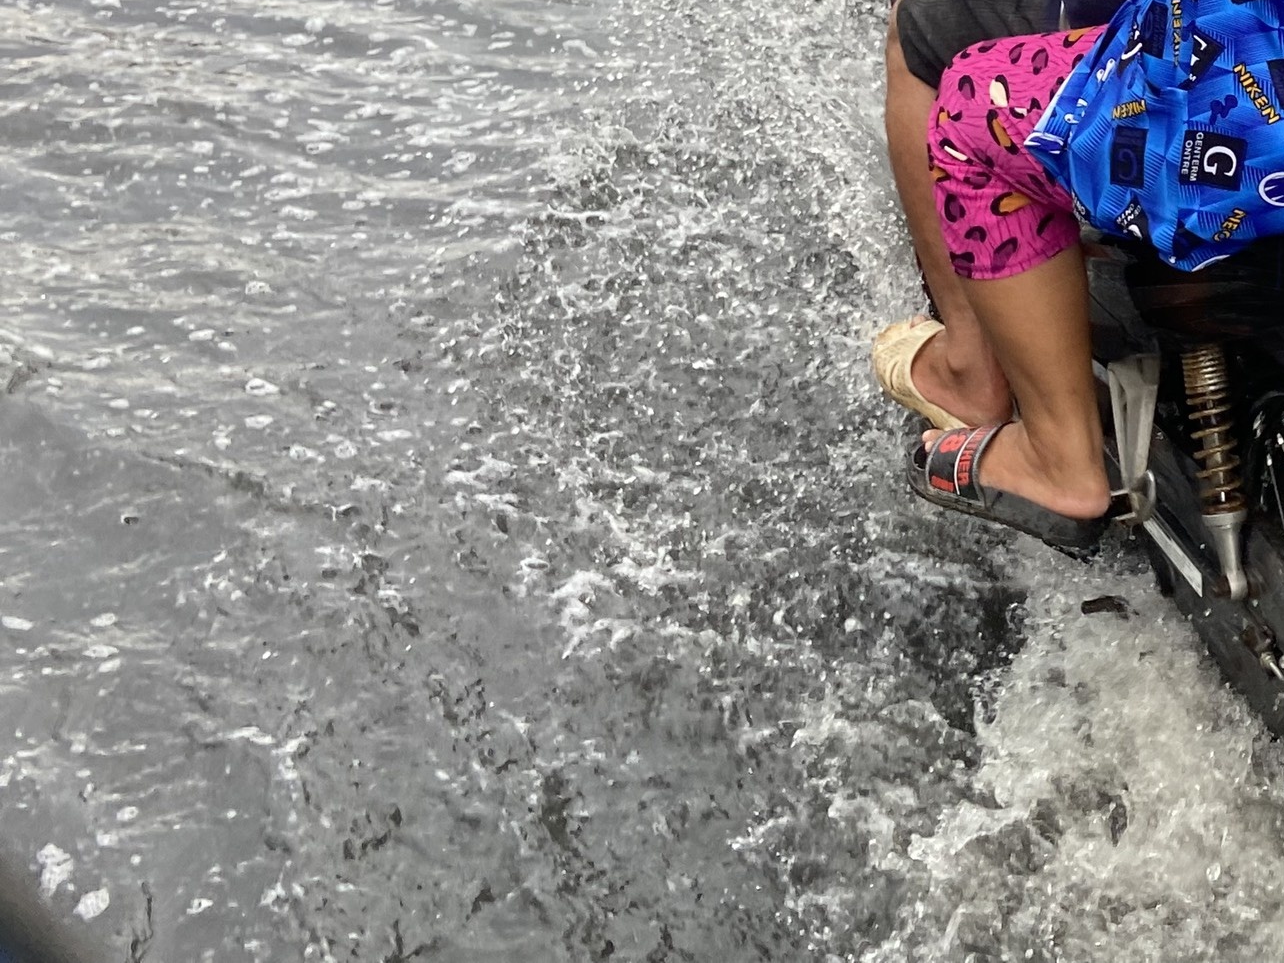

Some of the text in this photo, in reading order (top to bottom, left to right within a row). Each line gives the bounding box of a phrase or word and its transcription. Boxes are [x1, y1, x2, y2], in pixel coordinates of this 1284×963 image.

[1232, 63, 1281, 125] NIKEN
[1181, 139, 1194, 175] ONTRE
[1190, 132, 1205, 182] GENTERM
[1203, 145, 1237, 177] G
